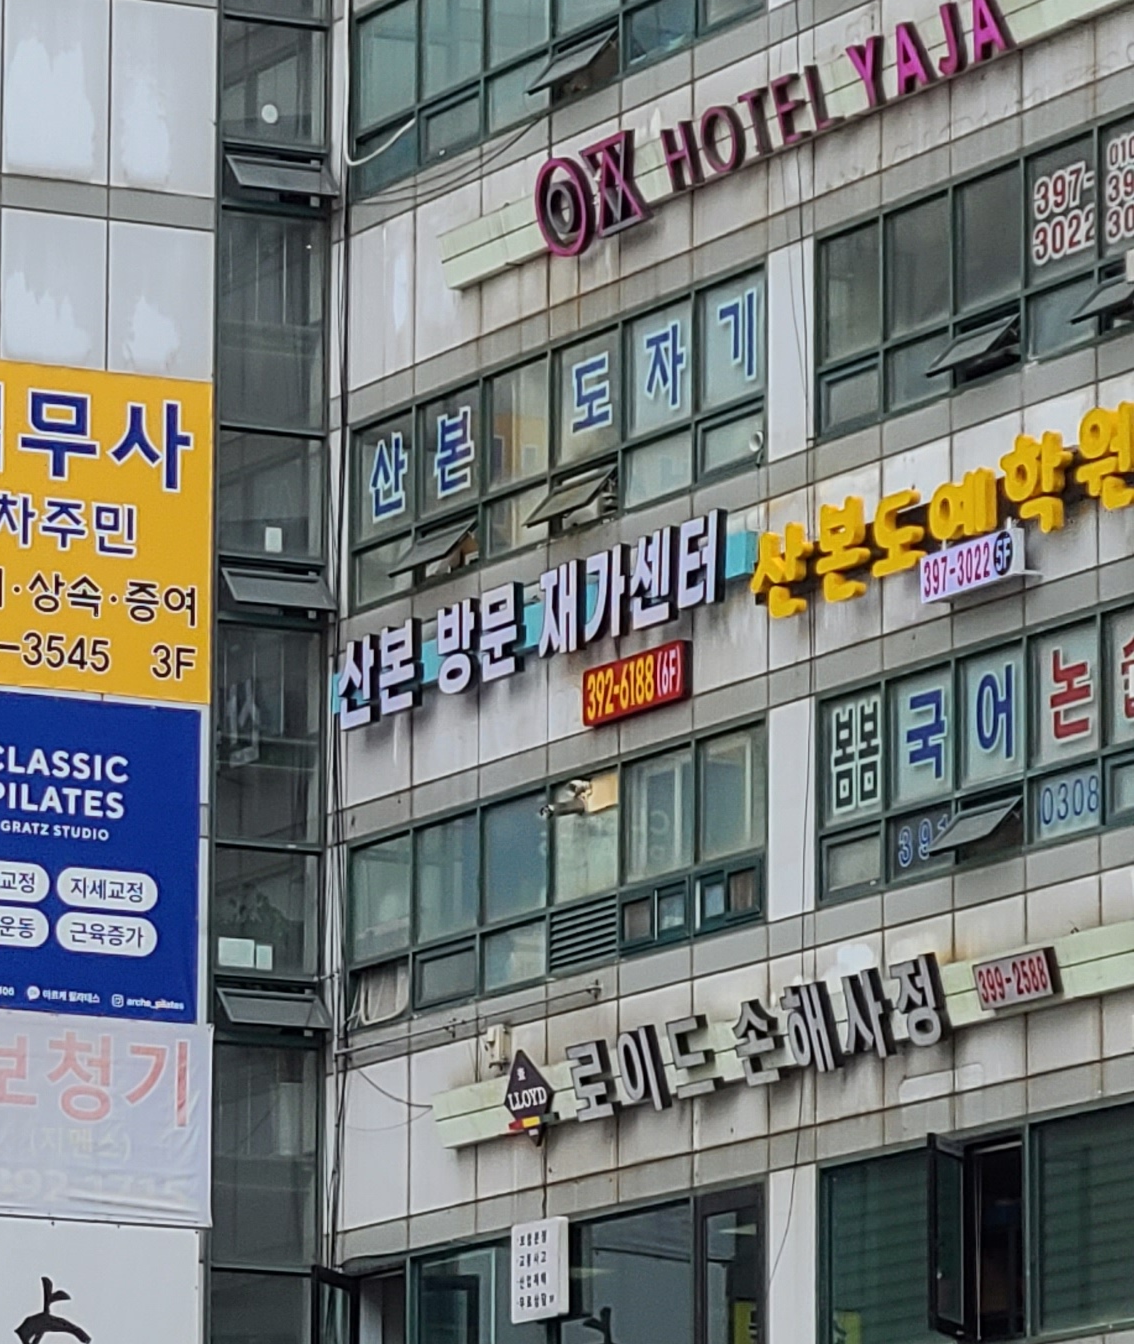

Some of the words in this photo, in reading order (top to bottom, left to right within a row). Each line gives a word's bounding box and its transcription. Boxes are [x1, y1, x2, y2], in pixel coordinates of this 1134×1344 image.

[661, 64, 844, 192] HOTEL
[370, 405, 475, 524] 산본
[571, 288, 760, 435] 도자기
[751, 401, 1134, 619] 산본도예학원
[923, 541, 991, 603] 397-3022
[995, 534, 1012, 574] 5F
[339, 617, 420, 731] 산본
[437, 581, 522, 695] 방문
[539, 509, 724, 657] 재가센터
[151, 643, 197, 681] 3F
[905, 663, 1014, 781] 국어
[1040, 774, 1100, 826] 0308
[0, 819, 49, 836] GRATZ
[53, 823, 110, 842] STUDIO
[70, 877, 144, 904] 자세교정
[69, 921, 144, 949] 근육증가
[977, 960, 1052, 1009] 399-2588
[507, 1087, 547, 1111] LLOYD
